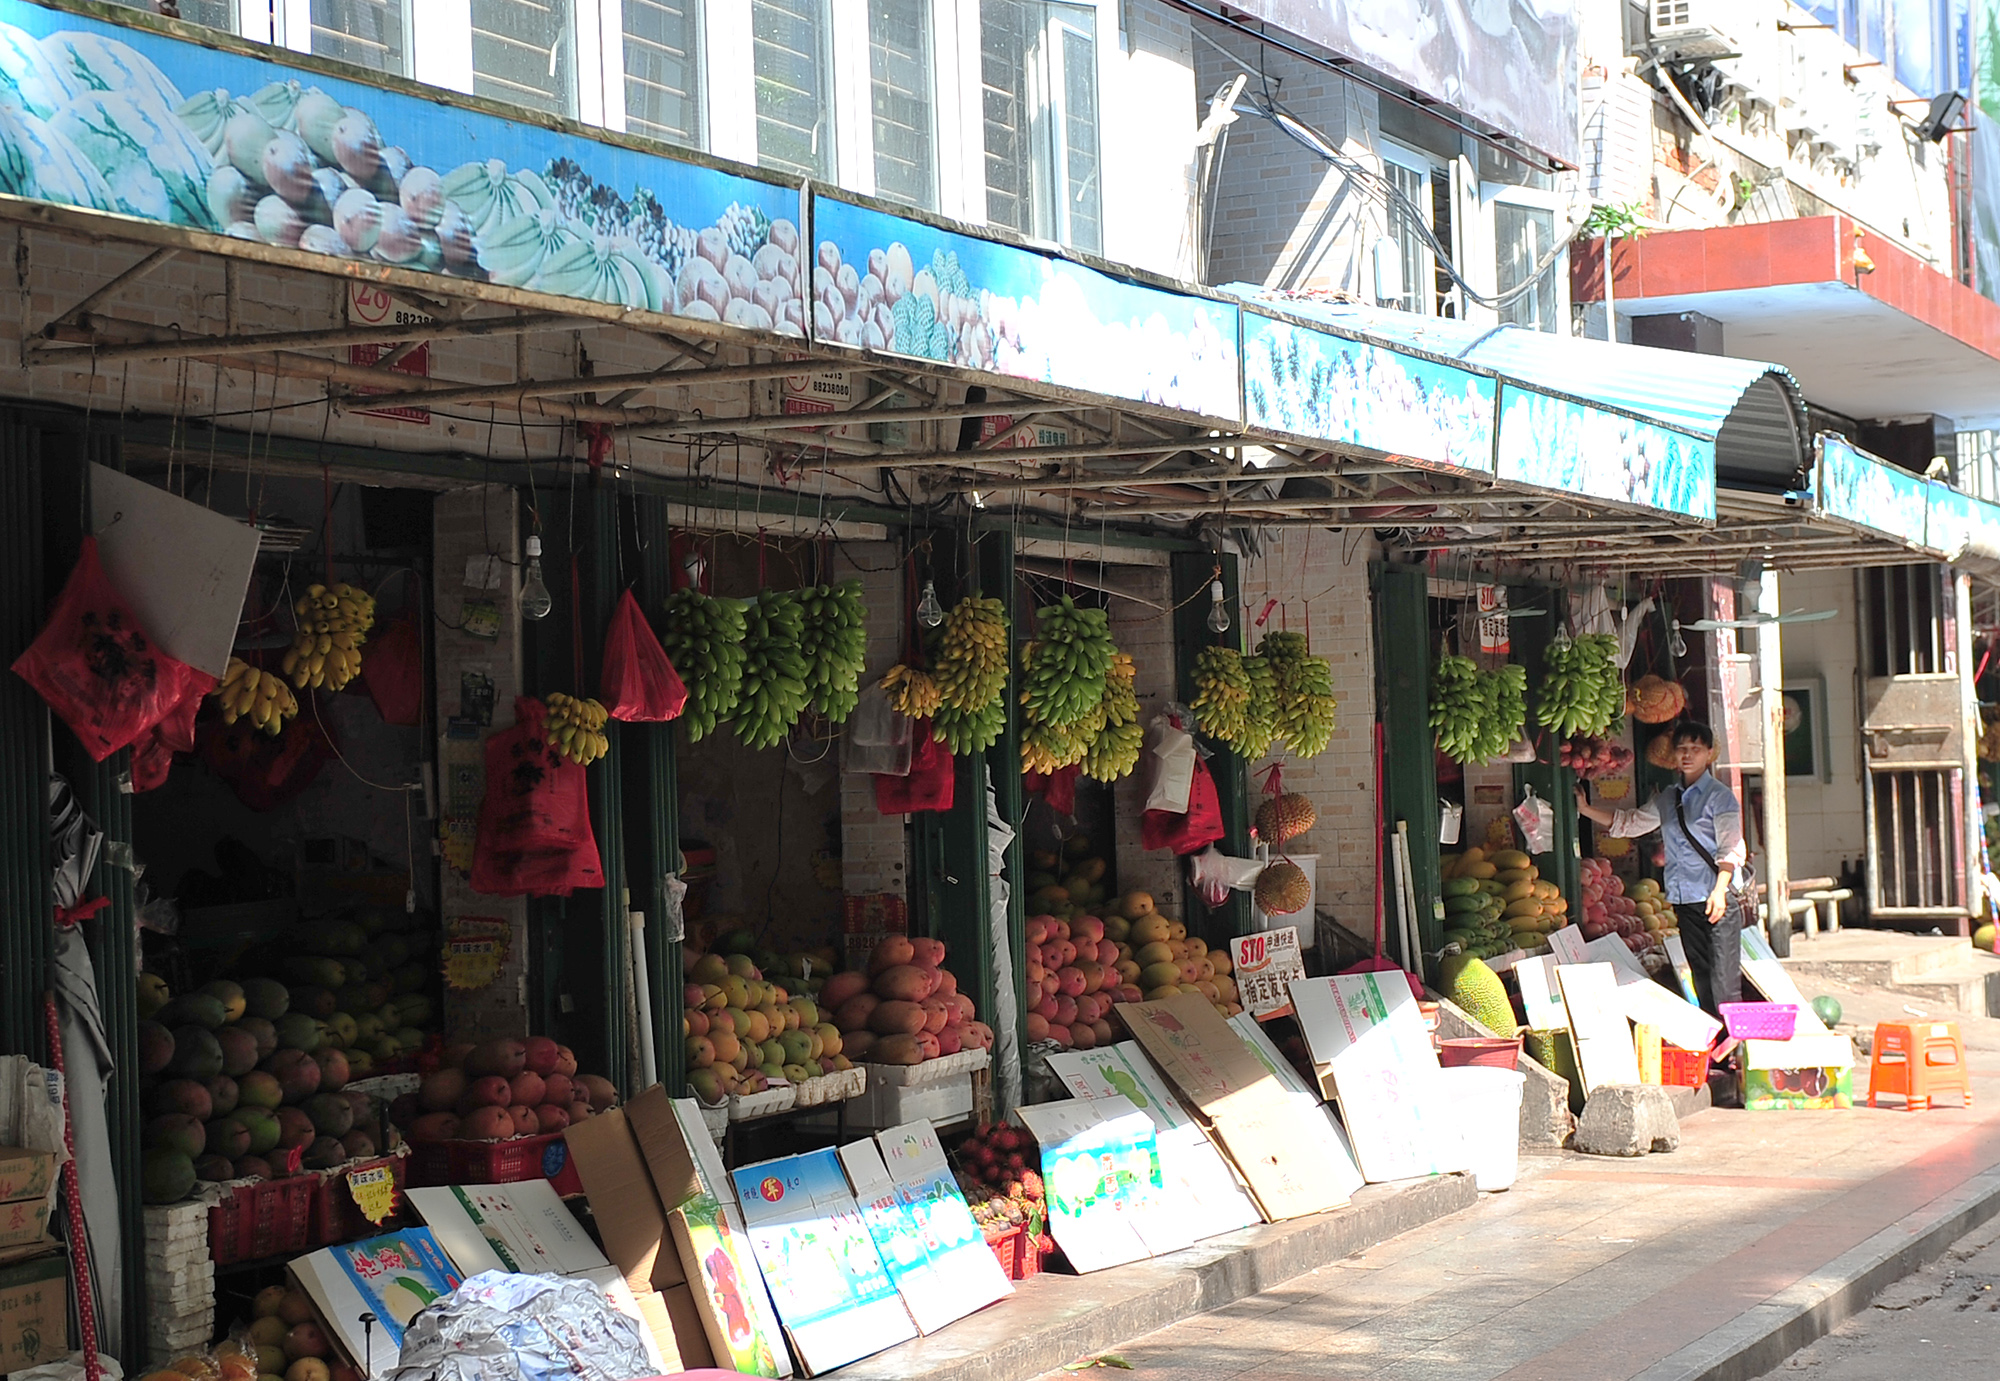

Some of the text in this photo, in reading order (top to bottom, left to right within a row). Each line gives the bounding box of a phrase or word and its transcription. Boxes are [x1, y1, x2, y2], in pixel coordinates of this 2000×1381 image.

[813, 381, 849, 396] 88238080
[1267, 931, 1293, 949] 申通快递
[1241, 937, 1264, 965] STO
